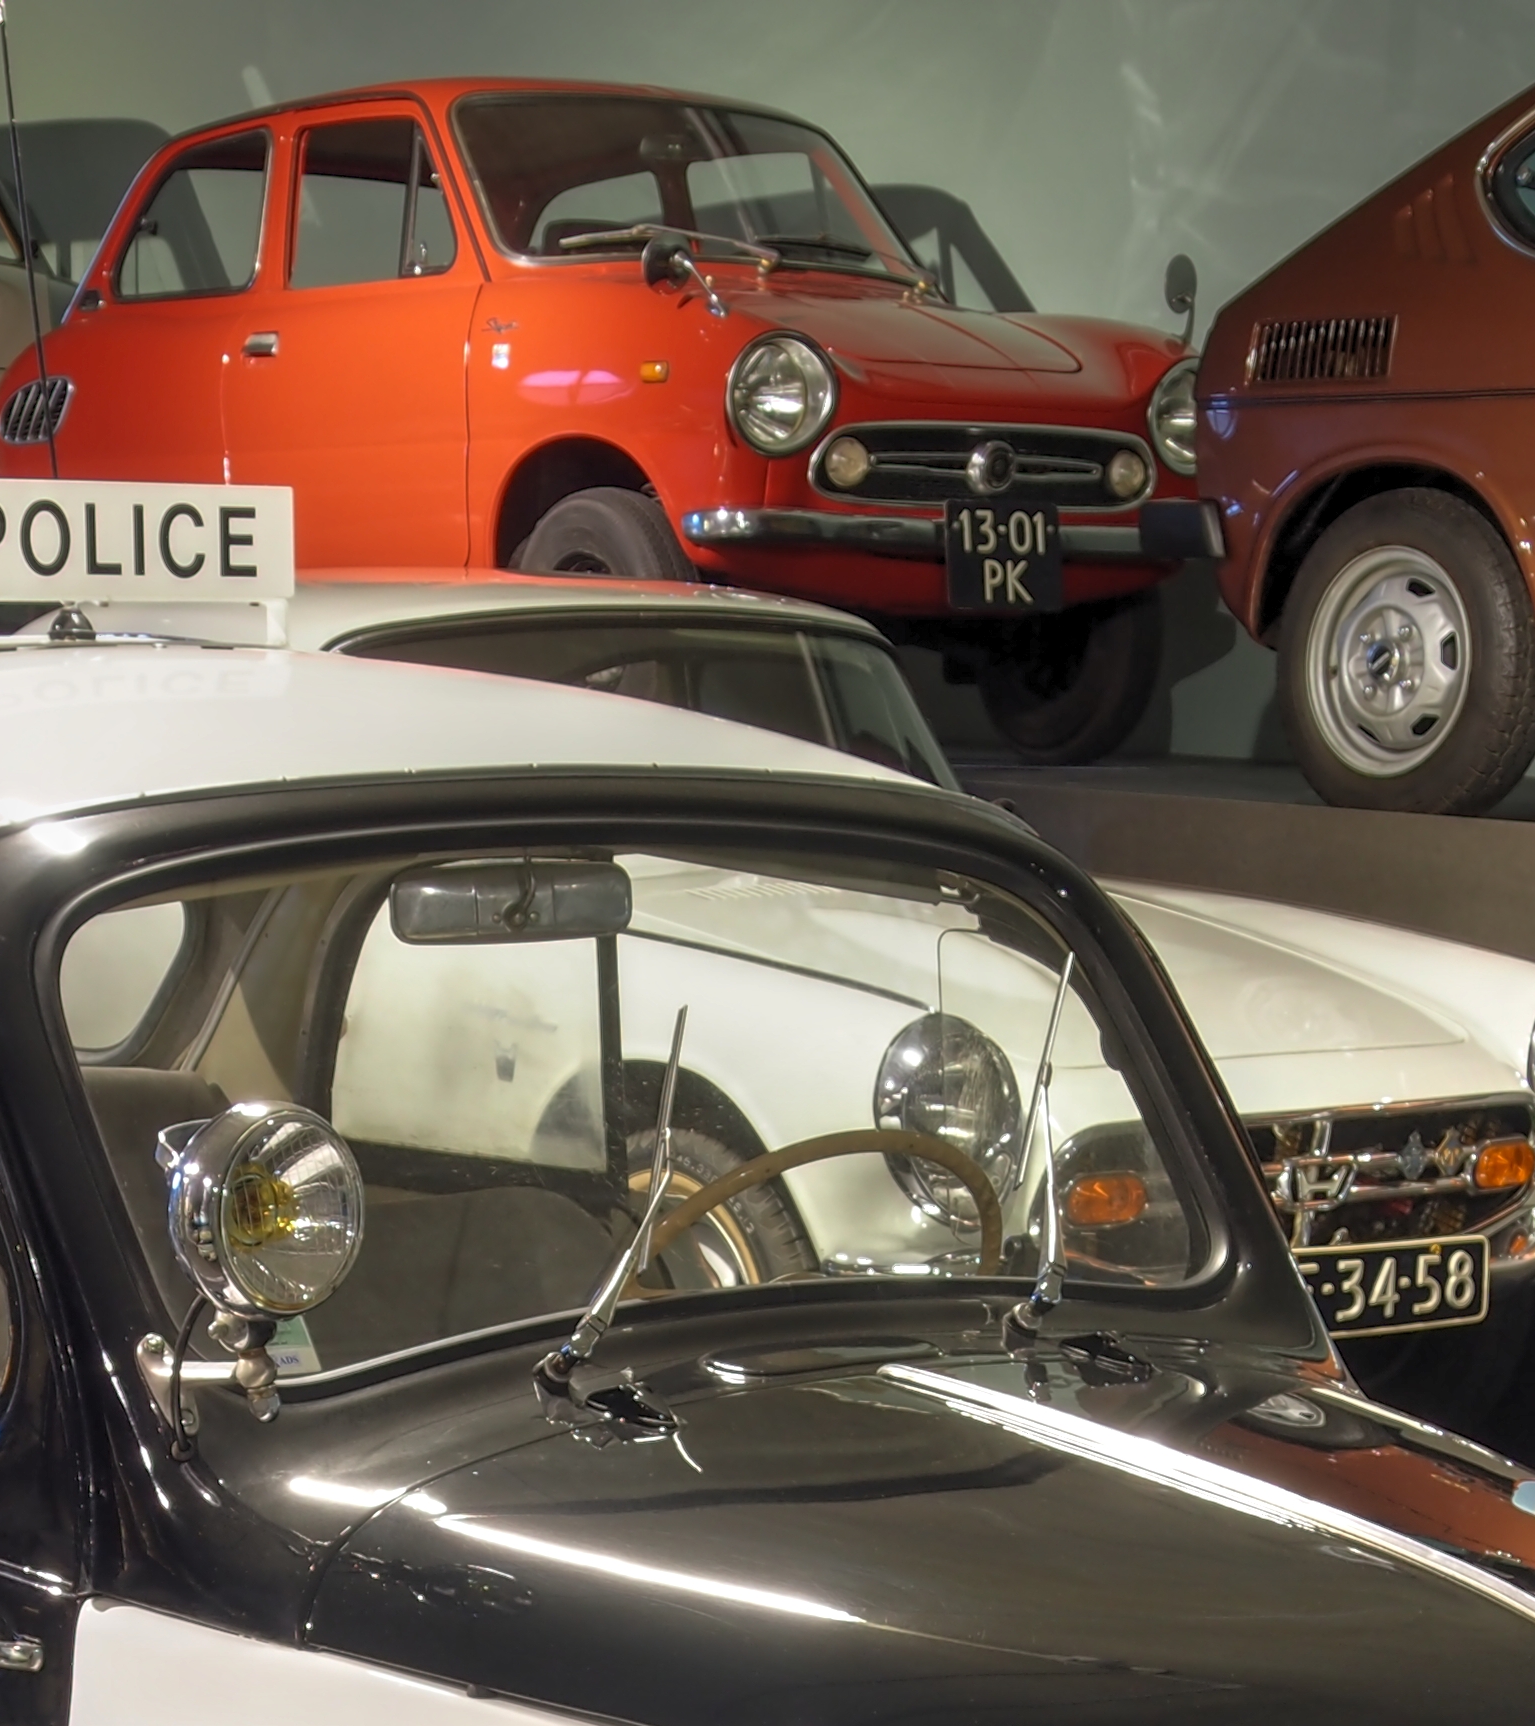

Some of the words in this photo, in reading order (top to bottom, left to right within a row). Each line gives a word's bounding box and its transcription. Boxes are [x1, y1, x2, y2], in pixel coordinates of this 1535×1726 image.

[959, 507, 1046, 555] 13-01
[983, 558, 1034, 605] PK
[1299, 1249, 1476, 1324] -34-58
